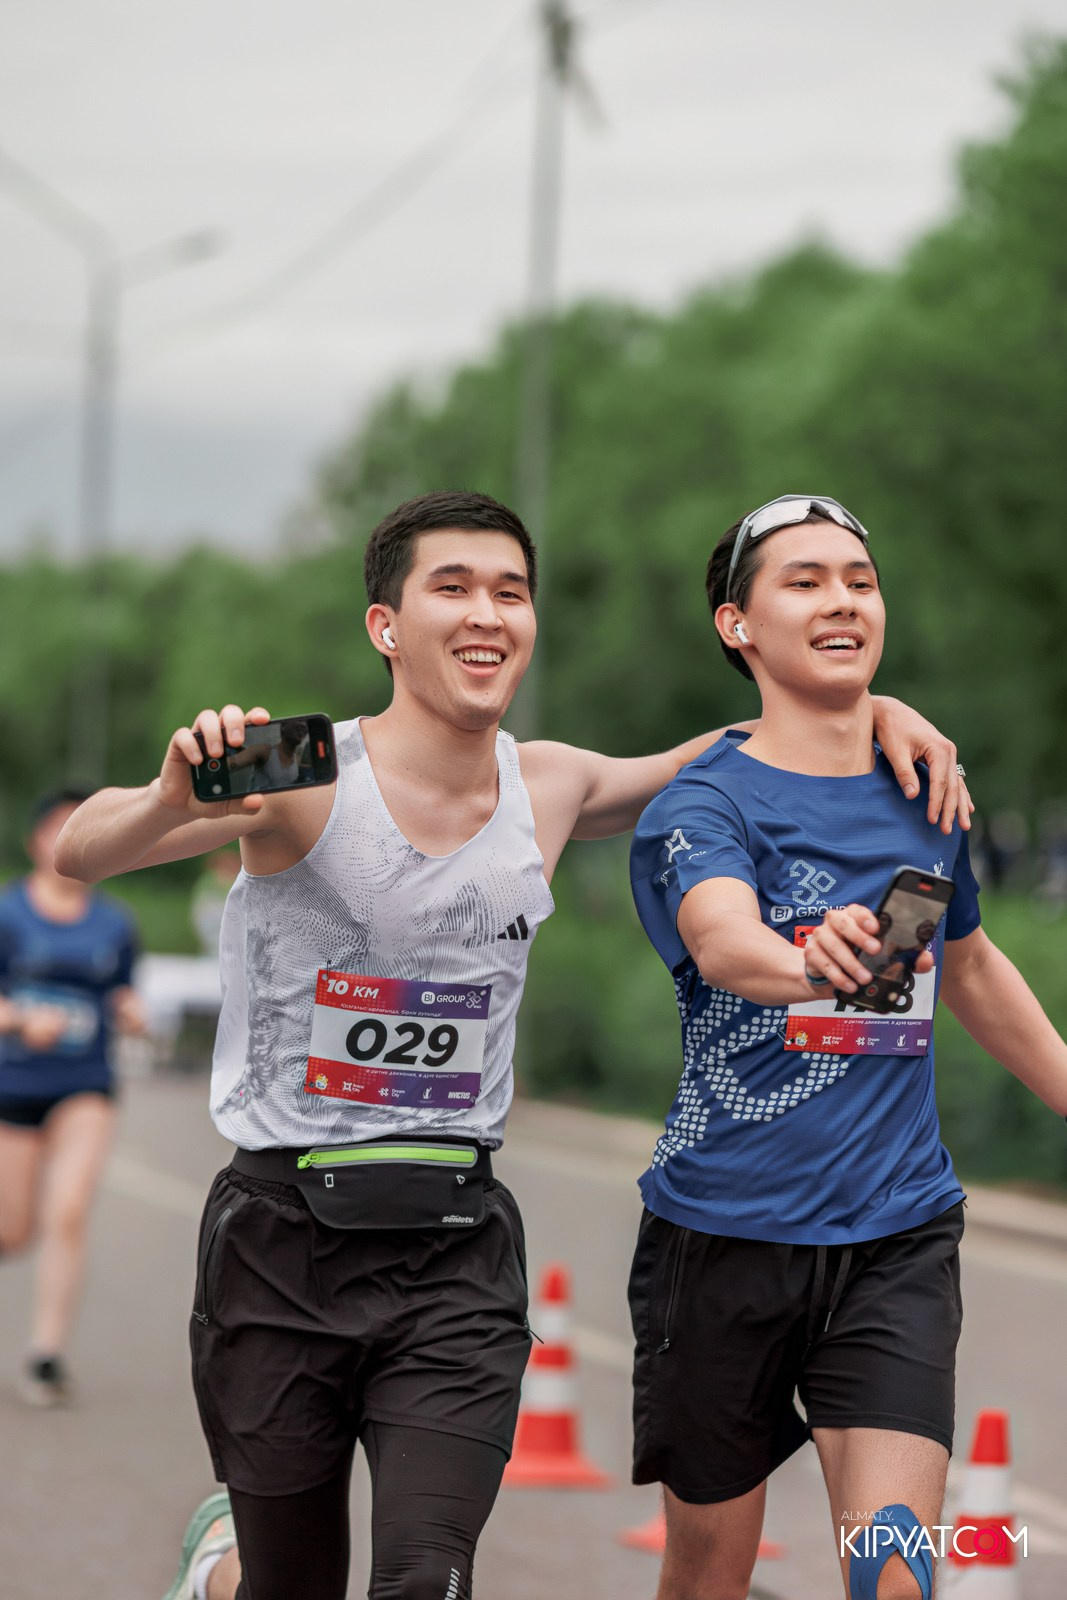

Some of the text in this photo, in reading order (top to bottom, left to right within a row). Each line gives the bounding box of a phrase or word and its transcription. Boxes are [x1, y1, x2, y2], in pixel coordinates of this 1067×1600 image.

[326, 979, 379, 1000] 10 KM
[436, 994, 466, 1003] GROUP
[345, 1018, 459, 1067] 029
